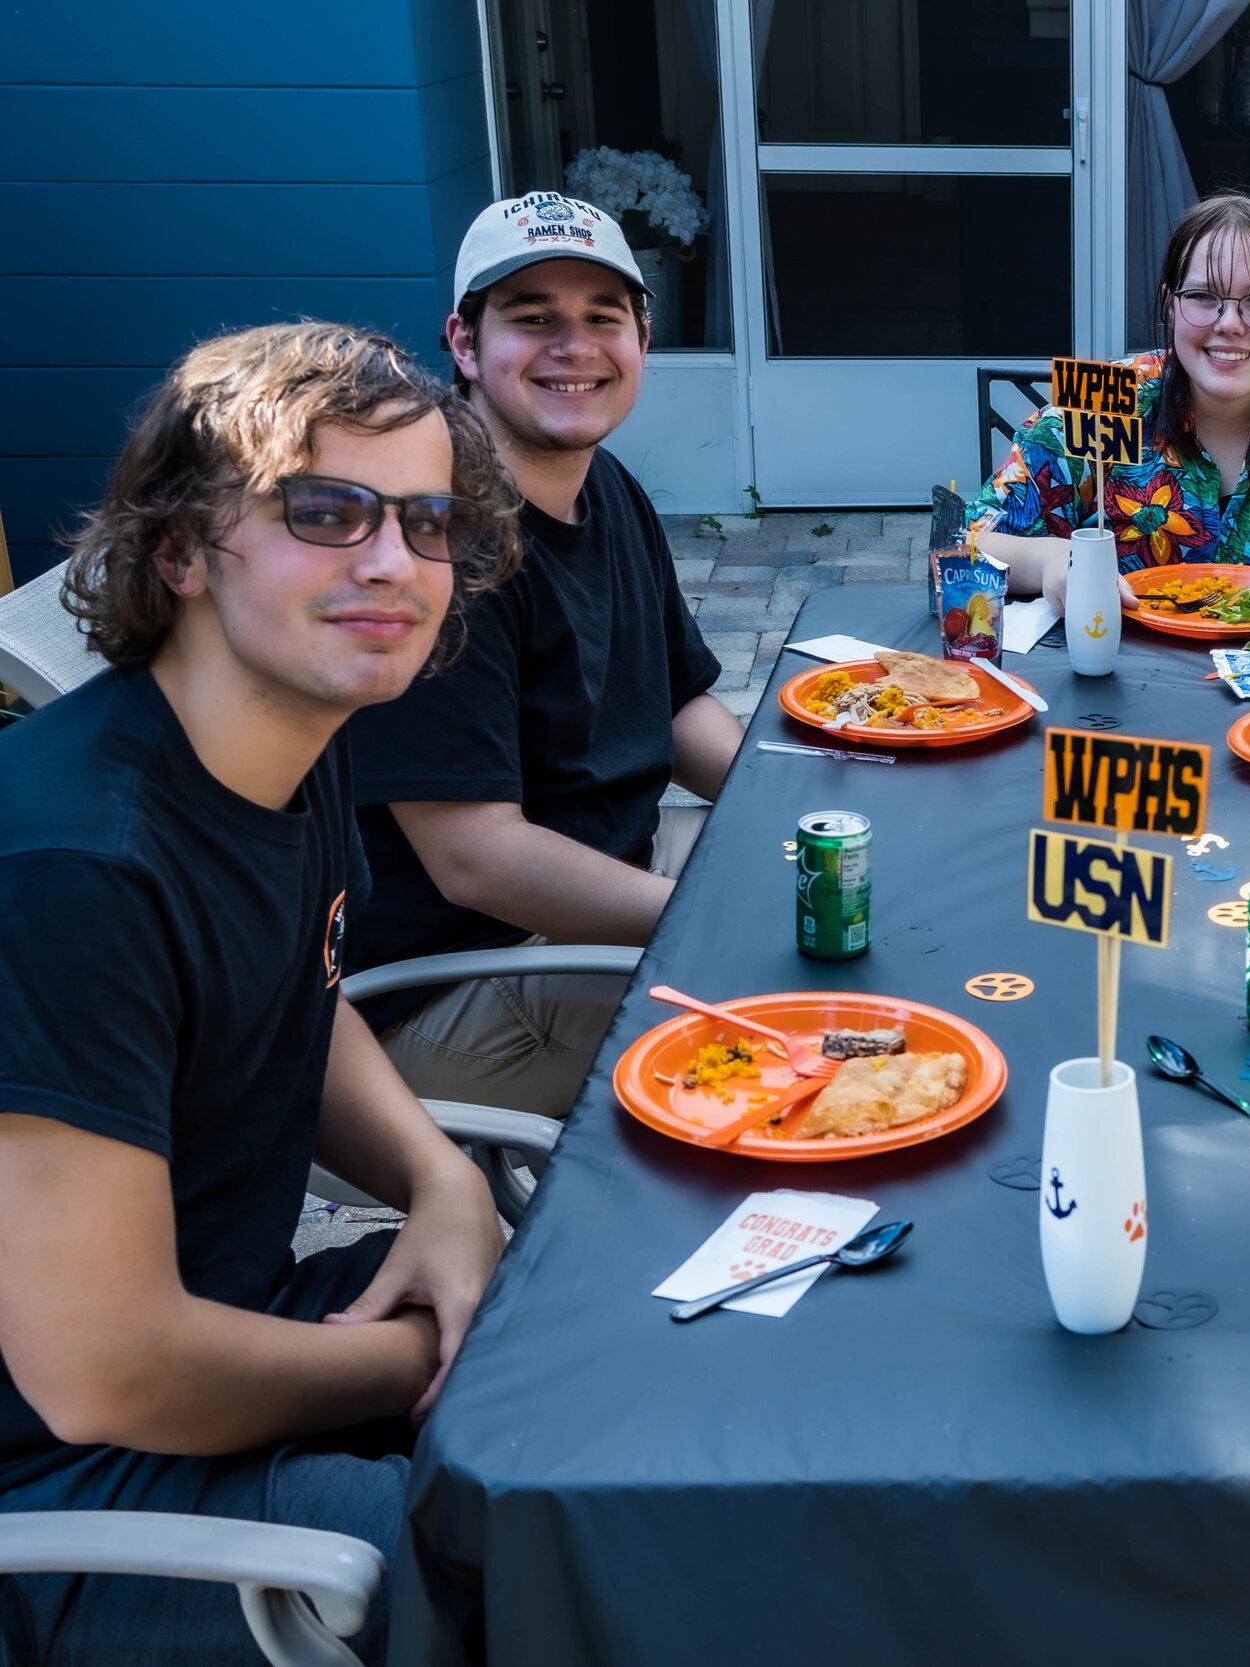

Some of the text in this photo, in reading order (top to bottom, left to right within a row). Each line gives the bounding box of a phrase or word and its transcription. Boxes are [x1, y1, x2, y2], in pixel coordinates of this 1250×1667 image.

[528, 224, 593, 239] RAMEN SHOP
[1055, 360, 1137, 416] WPHS
[1064, 410, 1139, 464] USN
[1050, 734, 1204, 835] WPHS
[1033, 834, 1166, 943] USN
[739, 1213, 838, 1247] CONGRATS
[743, 1235, 798, 1262] GRAD
